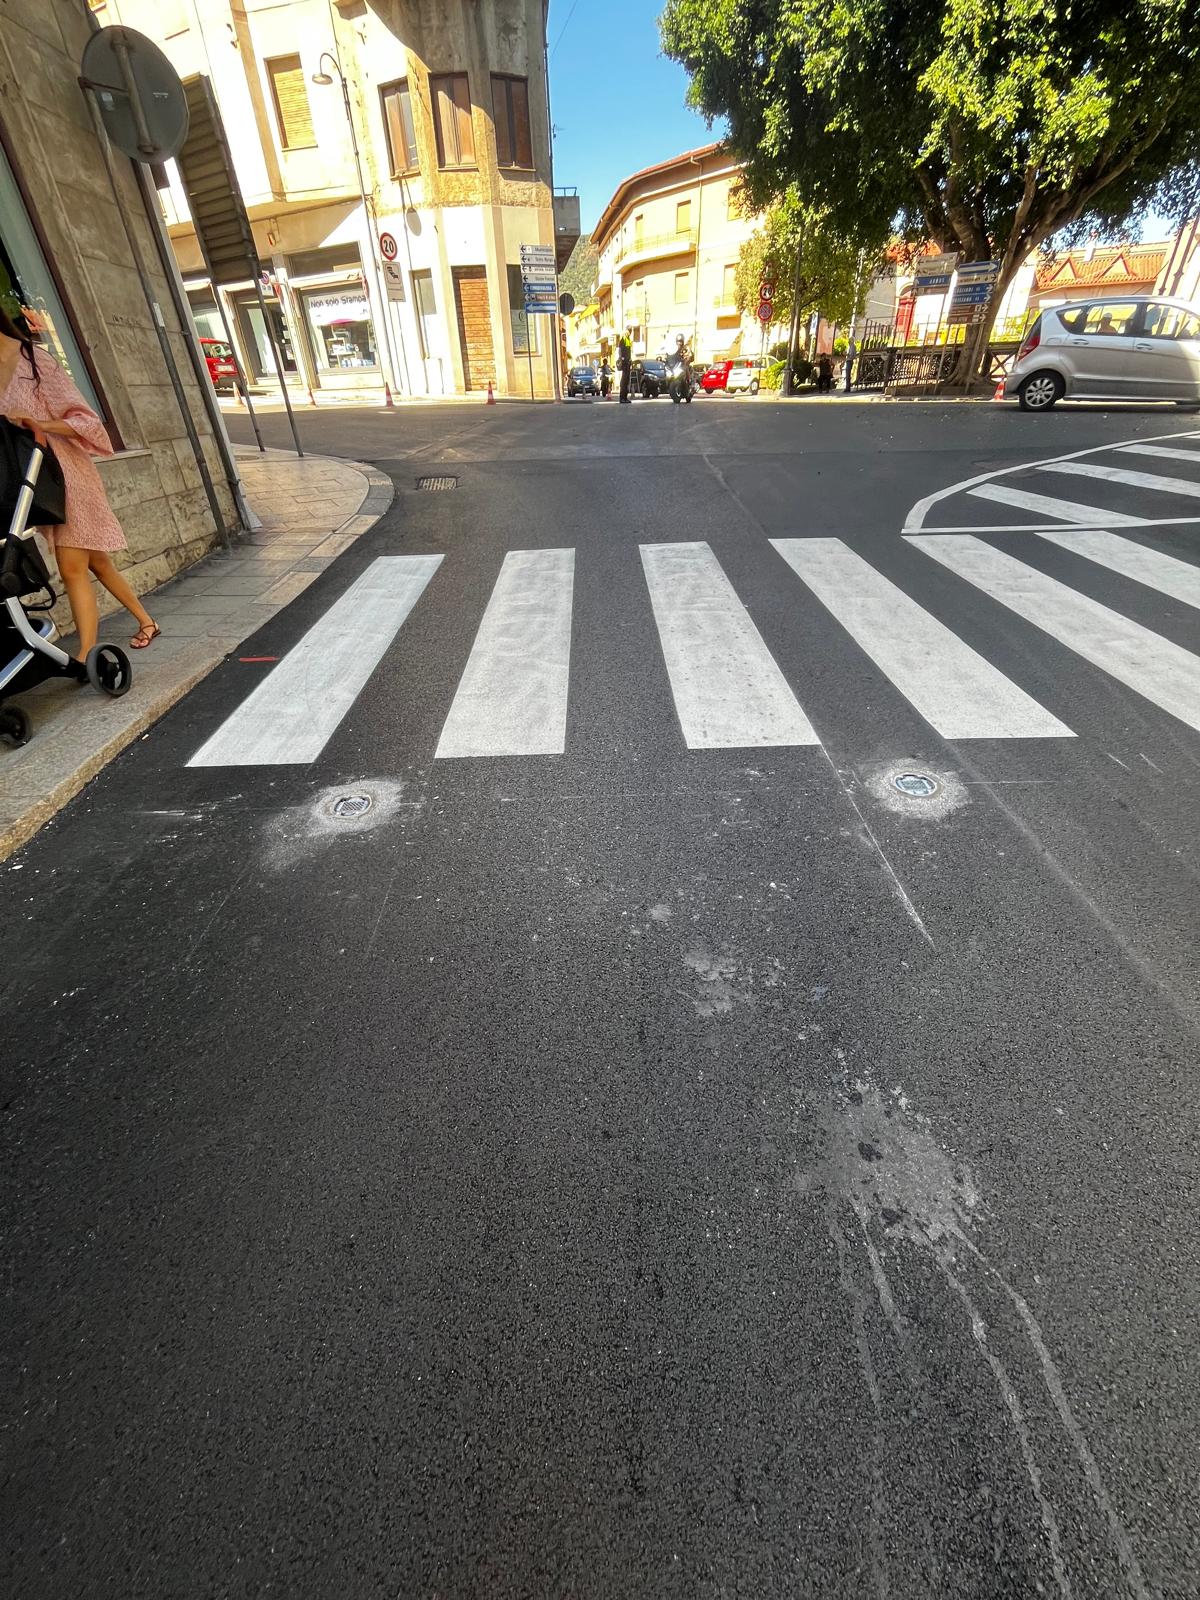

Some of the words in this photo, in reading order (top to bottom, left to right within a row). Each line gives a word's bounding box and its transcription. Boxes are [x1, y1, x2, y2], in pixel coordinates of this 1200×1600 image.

[383, 239, 395, 253] 20
[310, 299, 324, 309] Non
[325, 297, 339, 307] solo
[340, 294, 367, 305] Stampa
